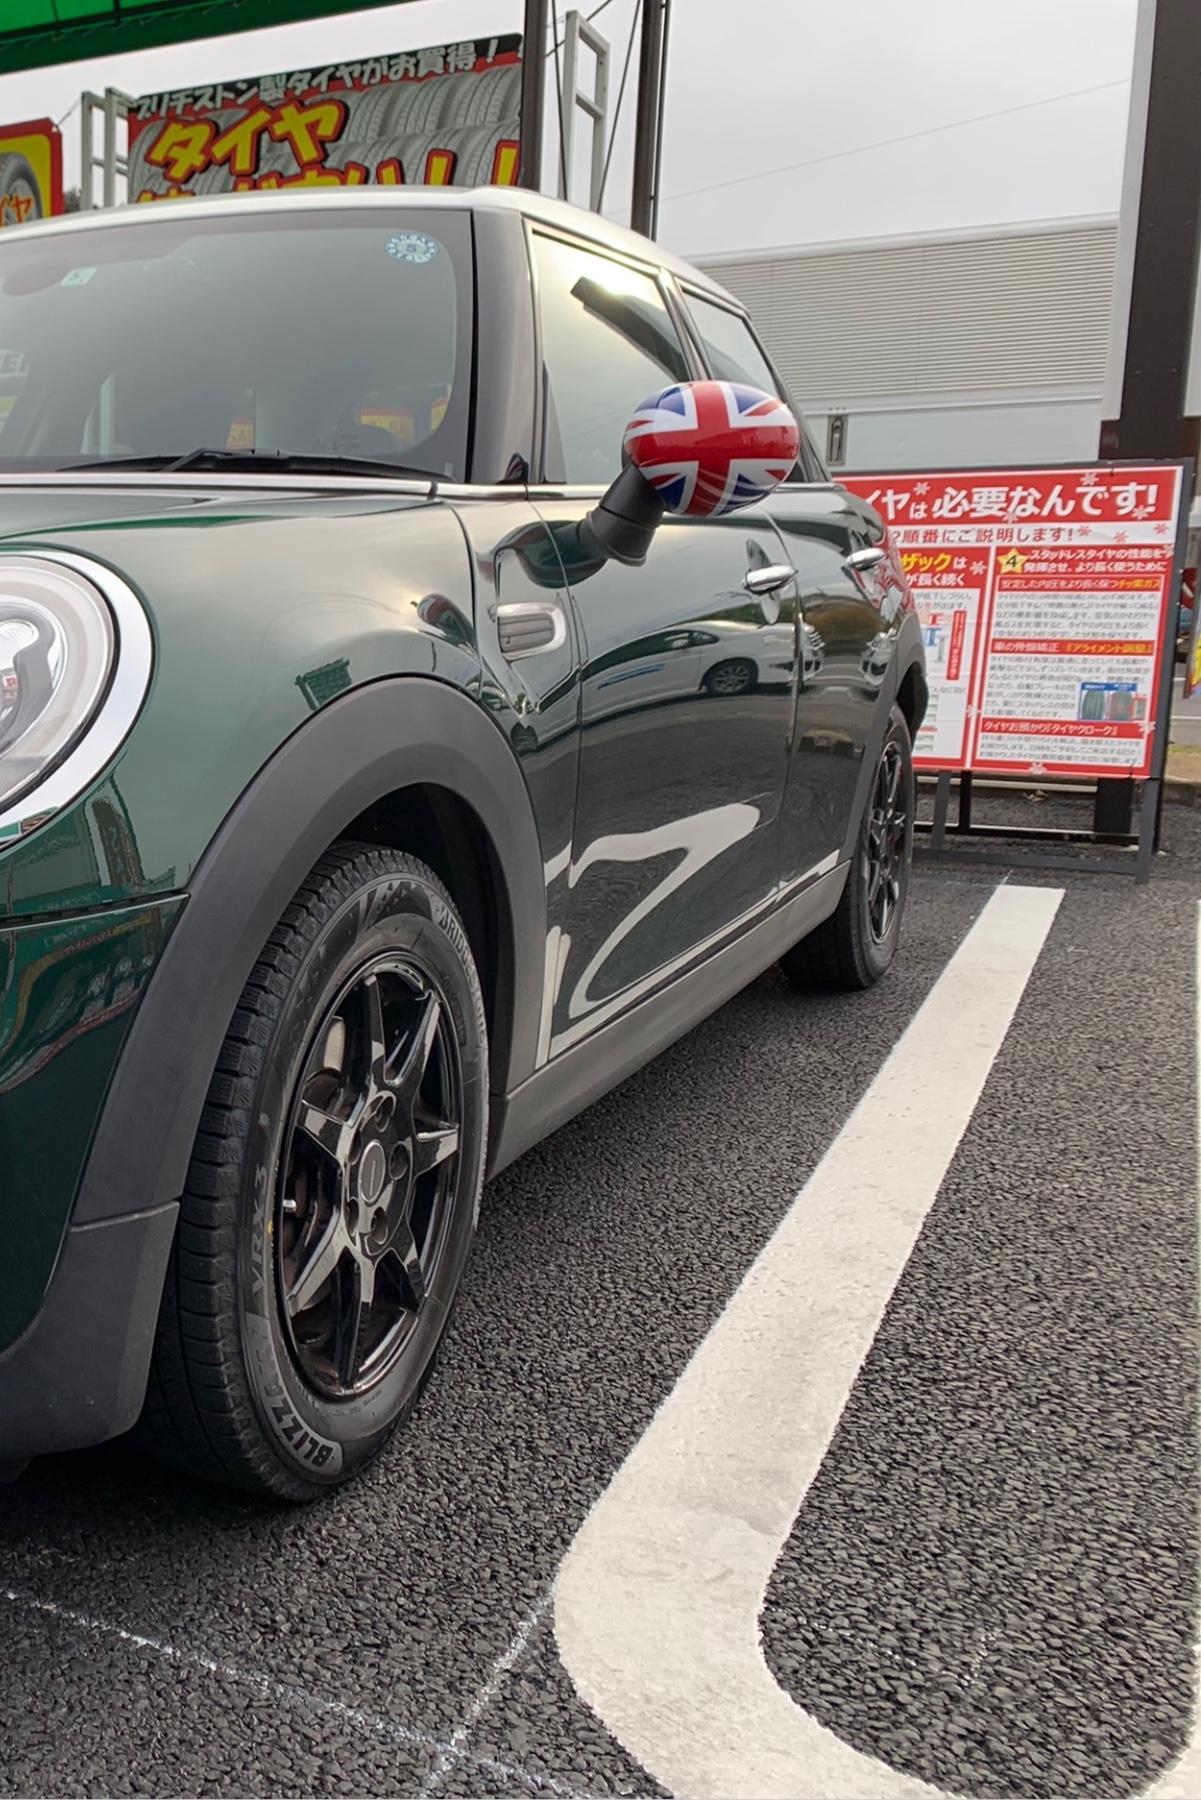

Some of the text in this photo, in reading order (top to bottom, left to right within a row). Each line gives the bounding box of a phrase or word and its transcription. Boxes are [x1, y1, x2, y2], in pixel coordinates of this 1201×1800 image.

[147, 102, 342, 181] タイヤ
[1006, 555, 1018, 568] 4
